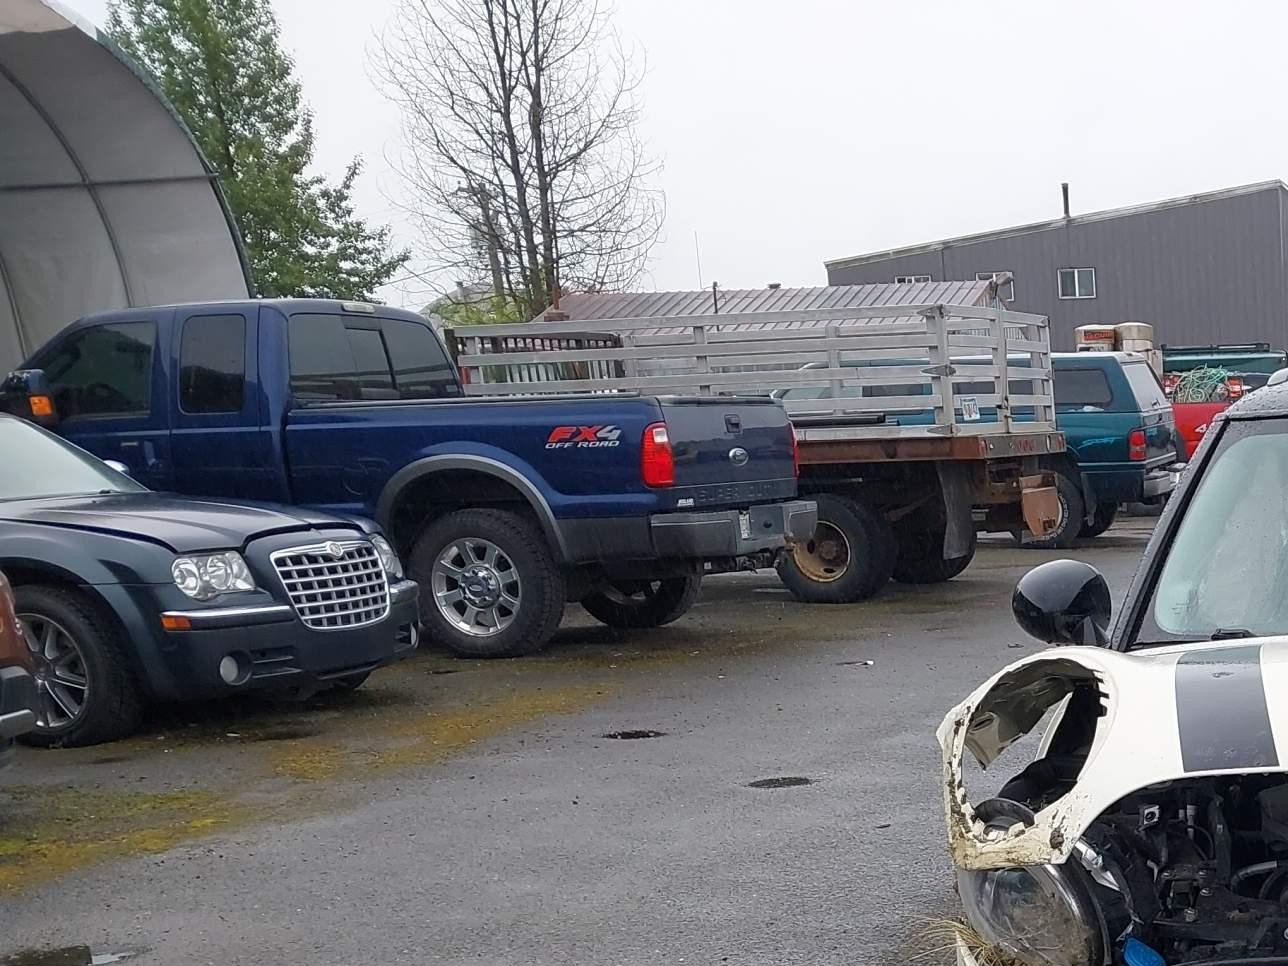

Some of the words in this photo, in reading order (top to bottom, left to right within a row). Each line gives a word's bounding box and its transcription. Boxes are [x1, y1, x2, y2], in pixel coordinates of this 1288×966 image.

[547, 424, 622, 443] FX4
[545, 441, 575, 449] OFF
[577, 440, 620, 448] ROAD
